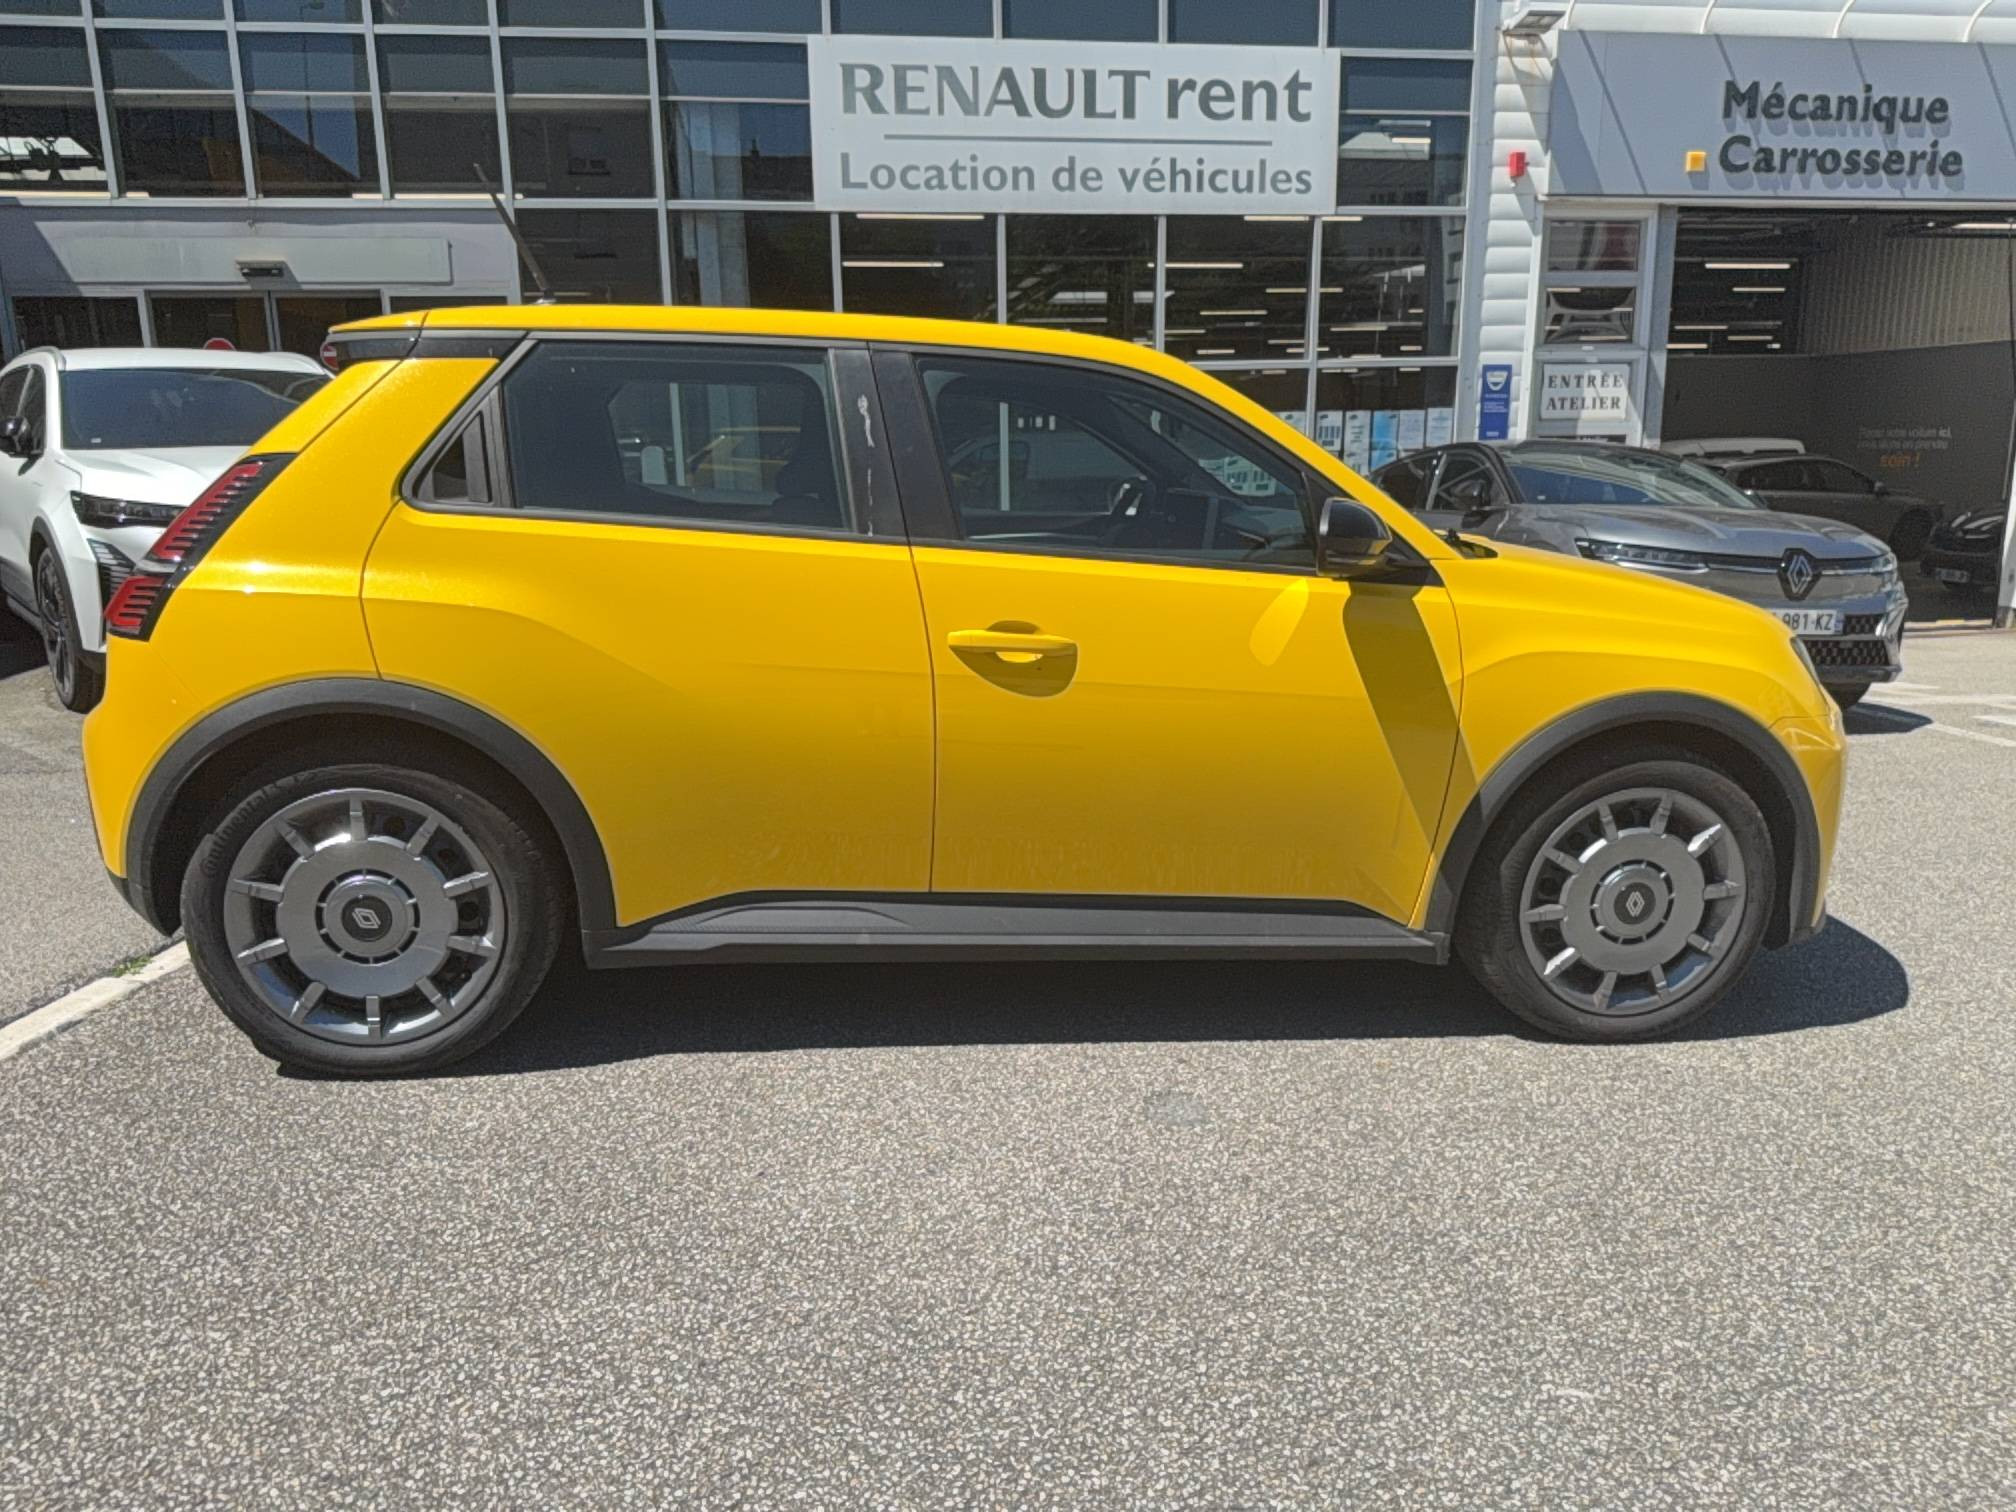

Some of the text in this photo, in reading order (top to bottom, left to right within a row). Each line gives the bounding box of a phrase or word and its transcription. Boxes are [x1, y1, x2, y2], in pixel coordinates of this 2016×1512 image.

[839, 62, 1313, 123] RENAULT rent
[1721, 80, 1950, 135] Mécanique
[840, 152, 1313, 195] Location de véhicules
[1718, 135, 1963, 178] Carrosserie
[1548, 372, 1623, 389] ENTRÉE
[1546, 396, 1621, 411] ATELIER
[1773, 612, 1834, 631] 981-KZ
